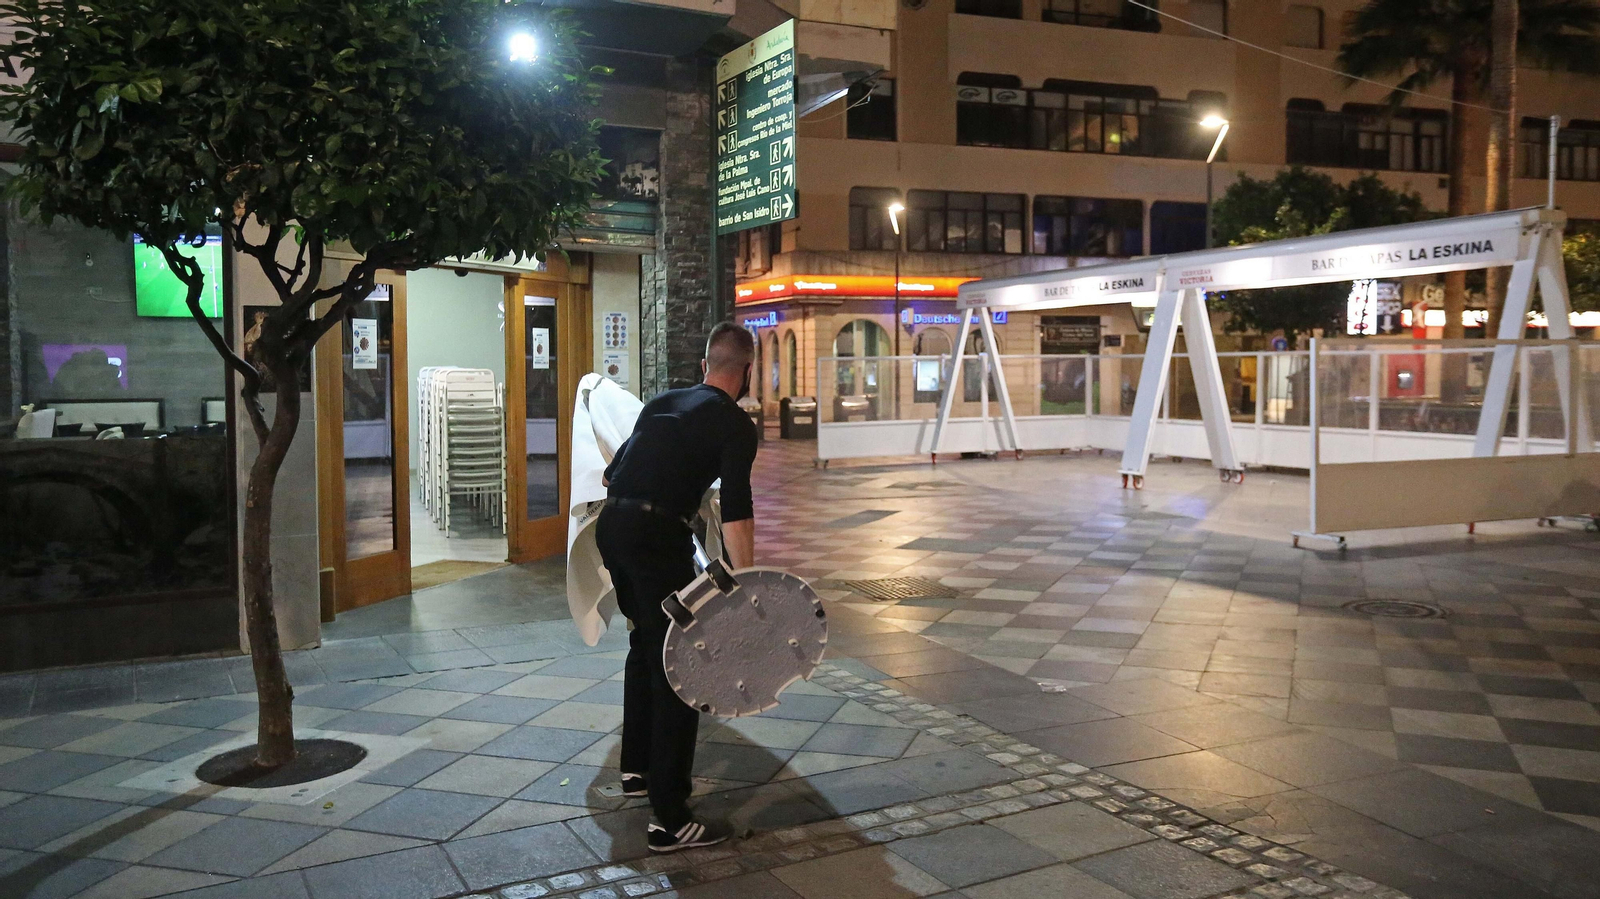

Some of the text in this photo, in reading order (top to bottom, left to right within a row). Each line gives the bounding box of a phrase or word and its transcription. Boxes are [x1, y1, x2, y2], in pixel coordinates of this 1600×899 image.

[746, 53, 792, 82] iglesia Ntra. Sra.
[763, 65, 792, 84] de Europa
[768, 80, 793, 97] mercado
[747, 92, 793, 118] Ingeniero Torroja
[753, 121, 767, 131] centro
[768, 117, 774, 126] de
[738, 134, 759, 148] congresos
[769, 127, 775, 136] de
[776, 125, 781, 133] la
[718, 158, 734, 172] iglesia
[750, 150, 760, 160] Sra.
[718, 166, 748, 182] de la Palma
[754, 177, 760, 186] de
[718, 185, 770, 206] cultura José Luis Cano
[718, 207, 769, 227] barrio de San Isidro
[1312, 258, 1335, 270] BAR
[1409, 249, 1427, 261] LA
[1433, 240, 1494, 258] ESKINA
[1044, 288, 1058, 297] BAR
[1100, 281, 1109, 291] LA
[1112, 278, 1144, 289] ESKINA
[1179, 276, 1213, 285] VICTORIA
[914, 314, 960, 324] Deutsche
